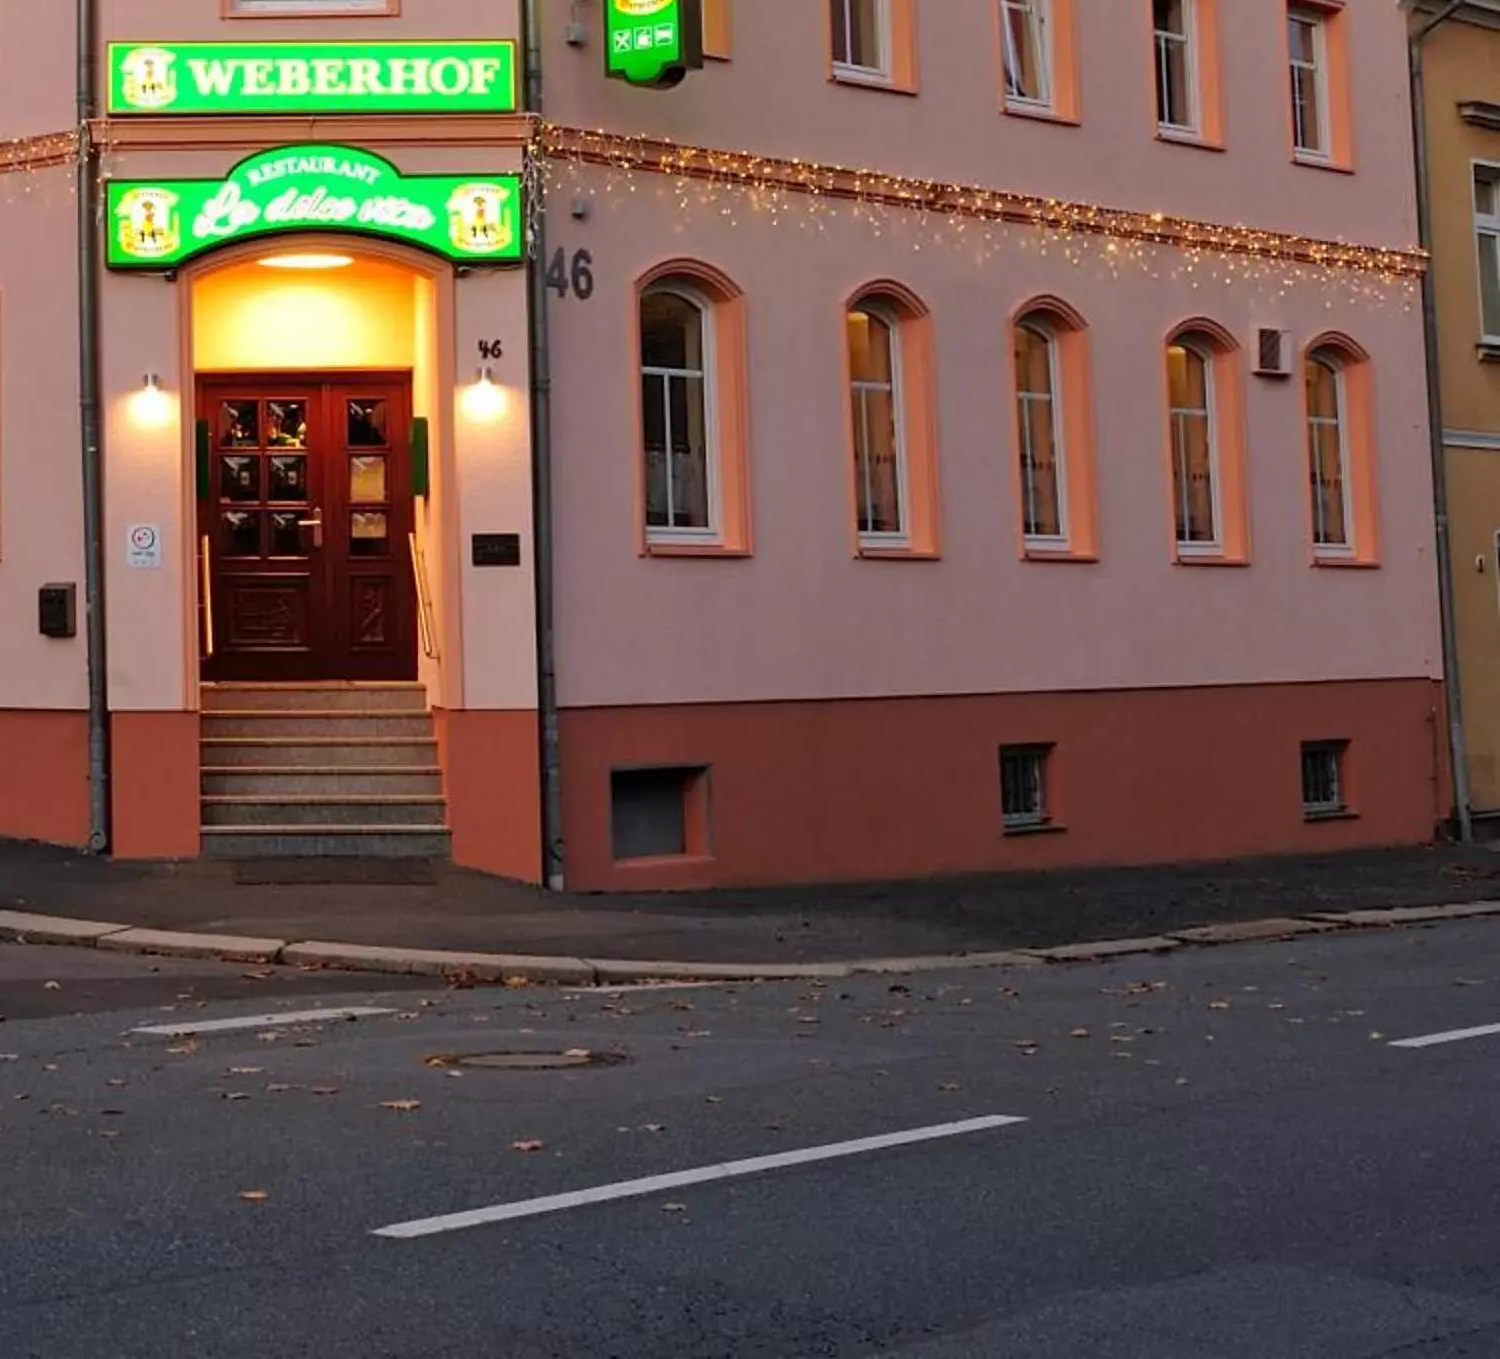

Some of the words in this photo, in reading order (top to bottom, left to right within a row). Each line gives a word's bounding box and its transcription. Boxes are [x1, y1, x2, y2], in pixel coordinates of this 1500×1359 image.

[186, 56, 500, 98] WEBERHOF
[245, 156, 382, 187] RESTAURANT
[545, 246, 594, 301] 46
[478, 339, 503, 360] 46
